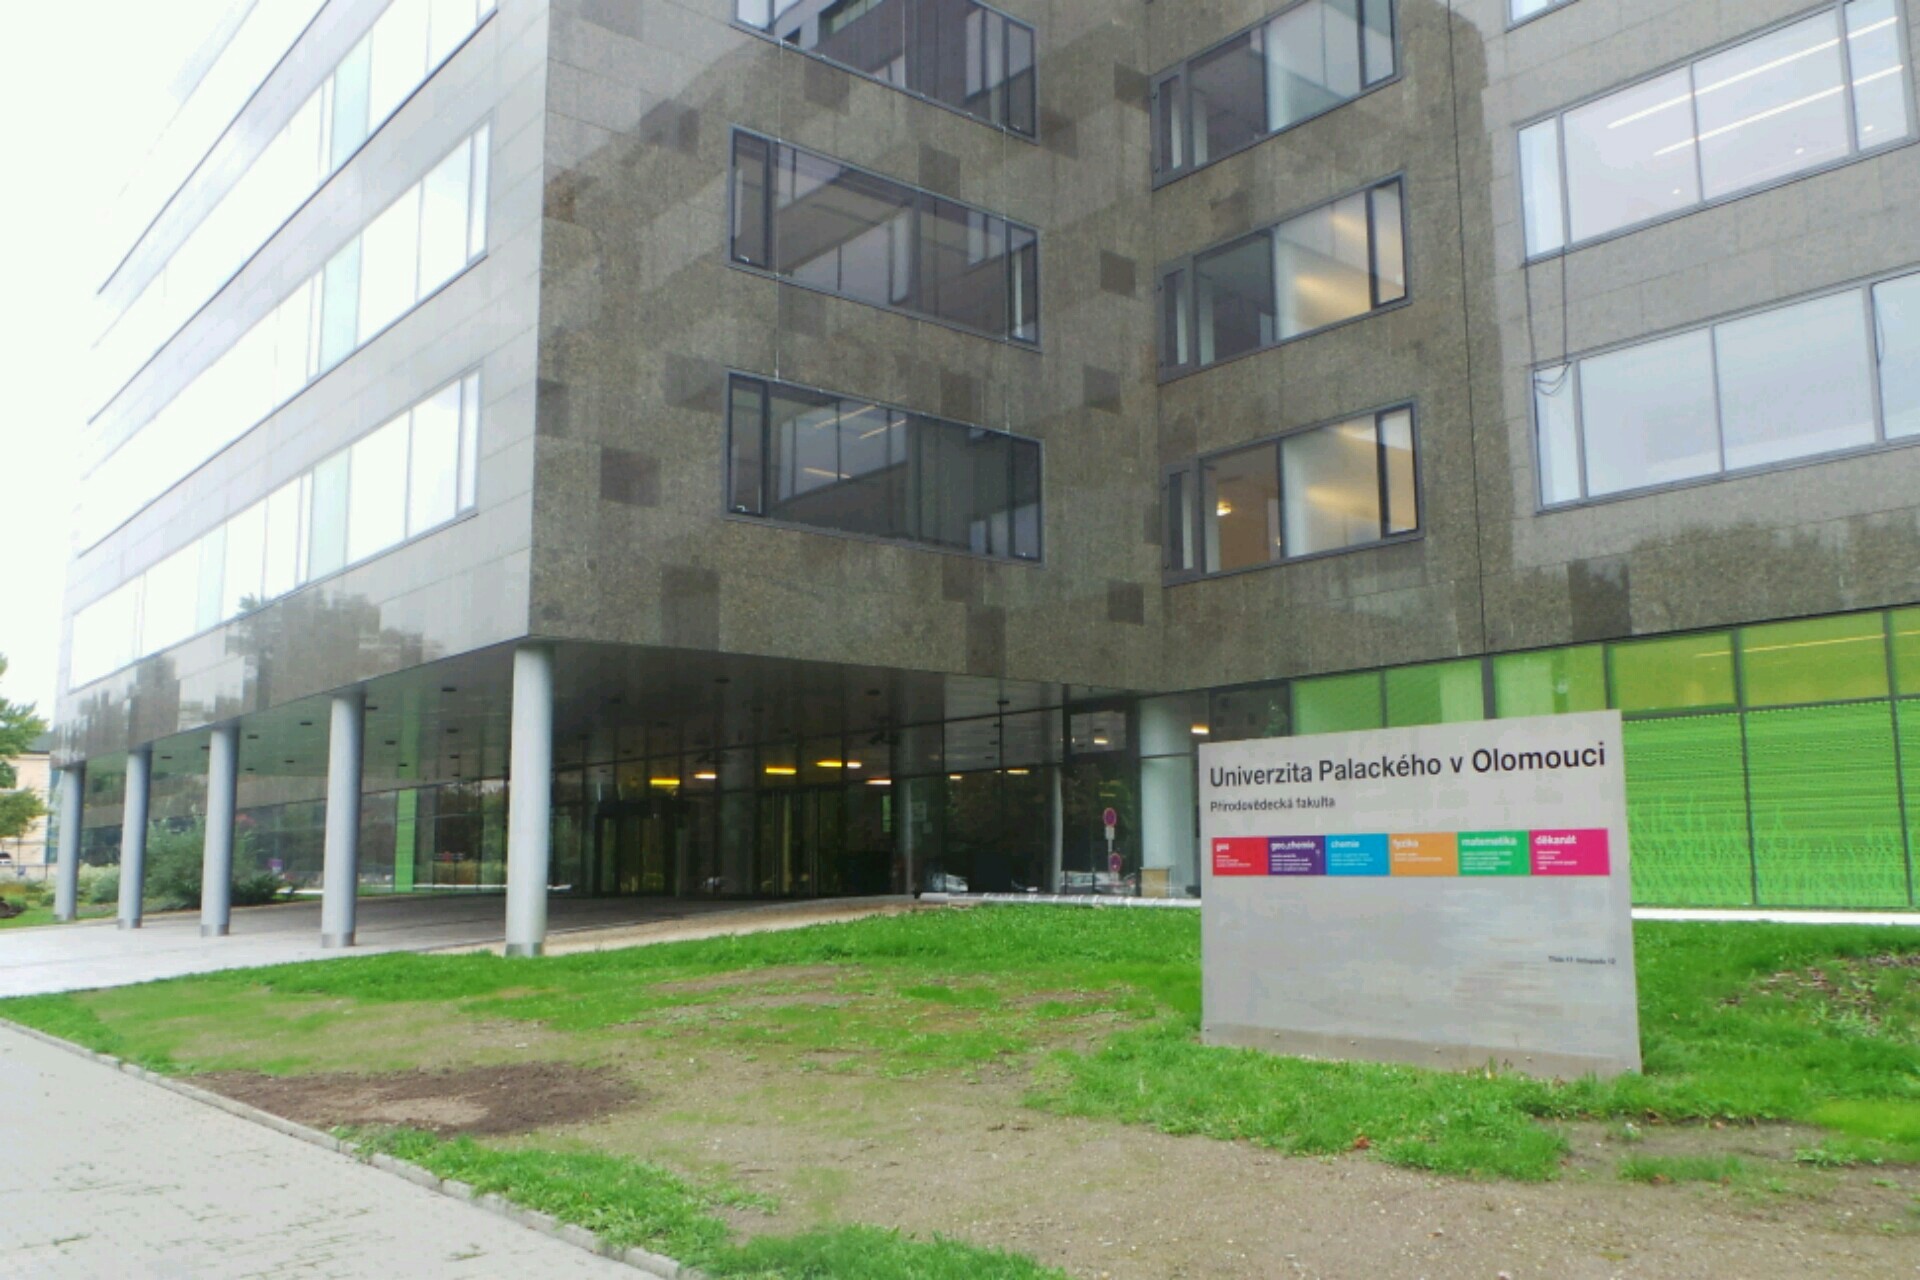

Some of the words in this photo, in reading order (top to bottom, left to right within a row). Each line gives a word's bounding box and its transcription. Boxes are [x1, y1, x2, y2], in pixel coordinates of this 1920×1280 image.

[1210, 762, 1312, 787] Univerzita
[1319, 754, 1442, 781] Palackého
[1450, 756, 1463, 773] v
[1472, 741, 1605, 773] Olomouci
[1297, 795, 1336, 809] fakulta
[1331, 839, 1360, 848] chemie
[1461, 836, 1518, 846] matematika
